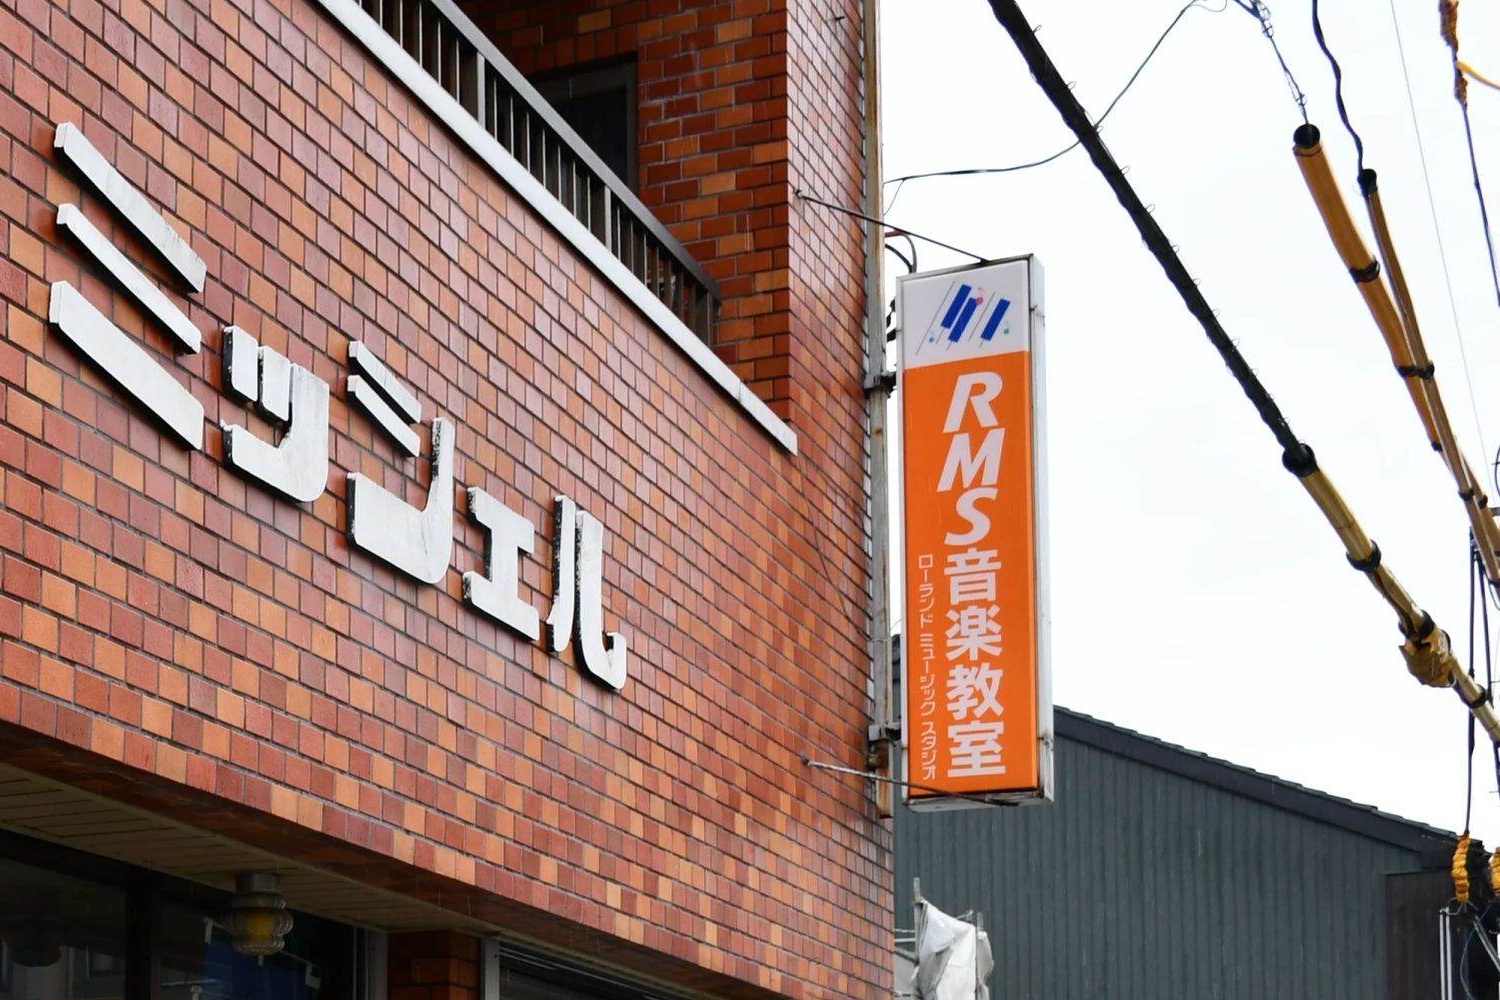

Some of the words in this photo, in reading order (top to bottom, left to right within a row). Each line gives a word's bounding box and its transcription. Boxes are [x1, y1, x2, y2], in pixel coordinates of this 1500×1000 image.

[49, 121, 627, 690] ミッシェル
[918, 553, 935, 629] ローランド
[919, 632, 936, 717] ミュージック
[920, 721, 937, 781] スタジオ
